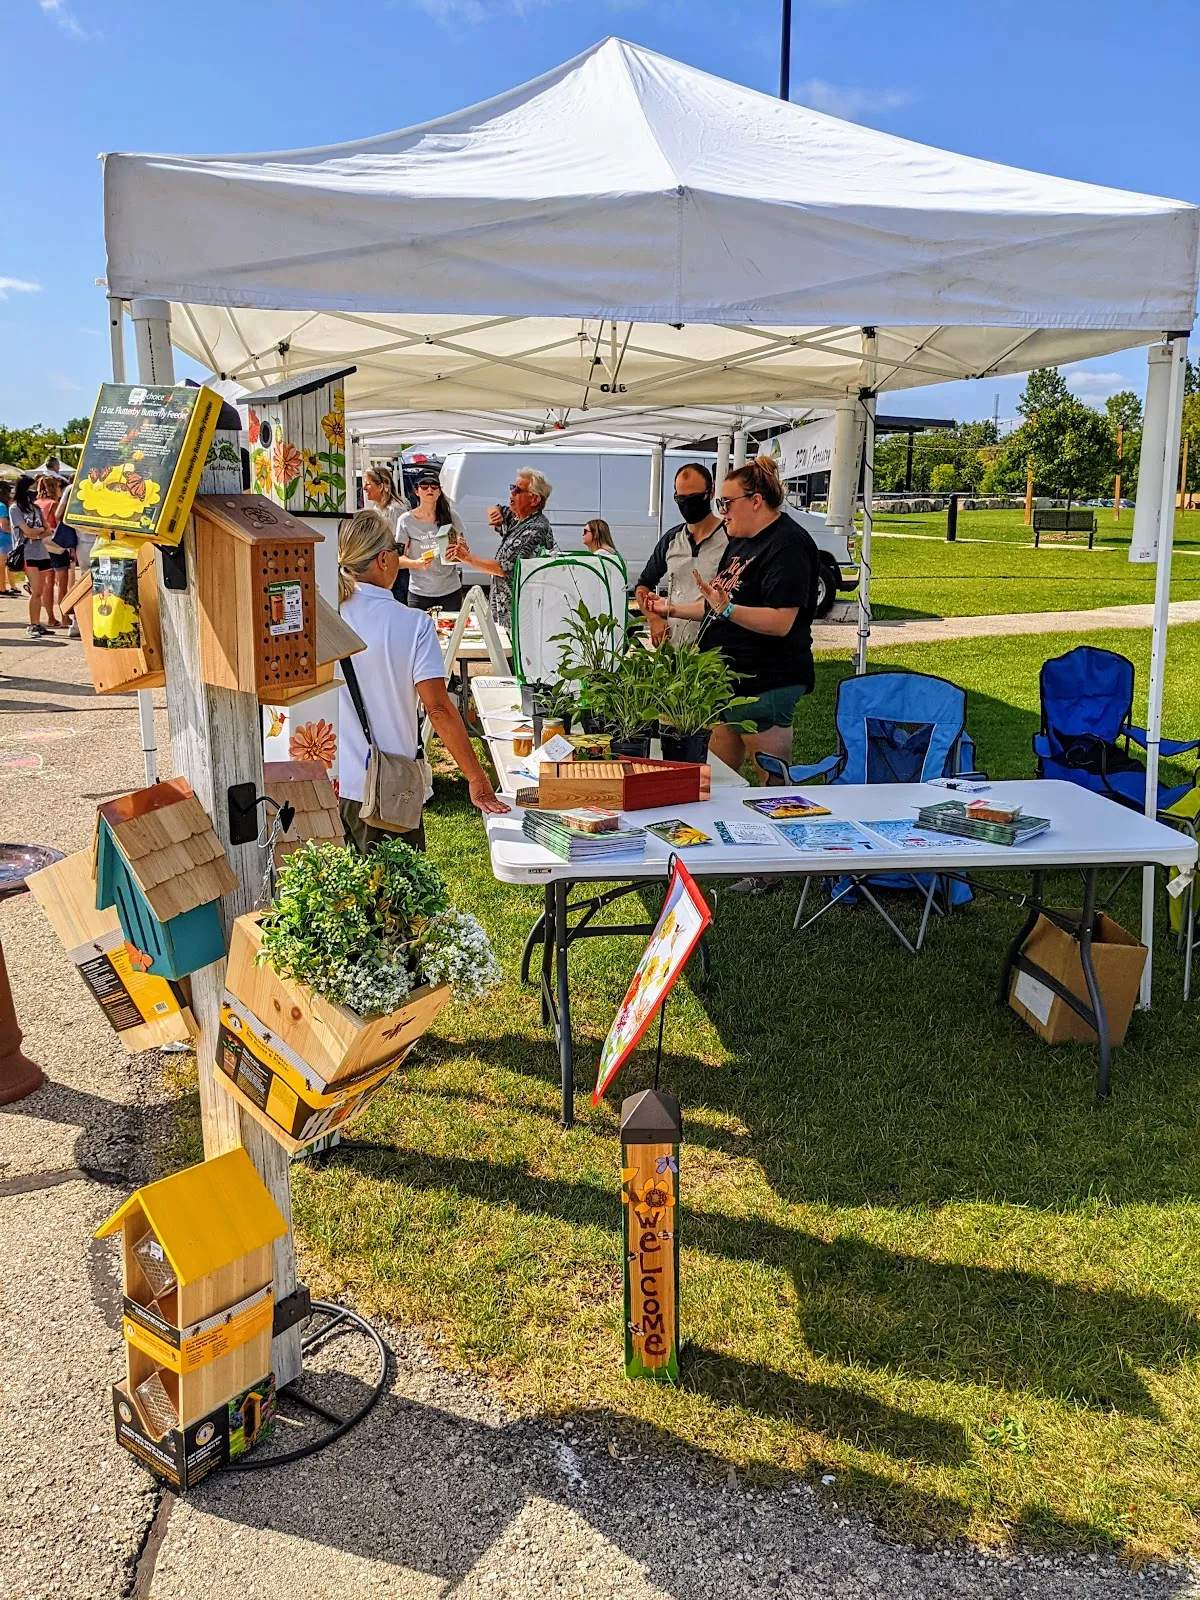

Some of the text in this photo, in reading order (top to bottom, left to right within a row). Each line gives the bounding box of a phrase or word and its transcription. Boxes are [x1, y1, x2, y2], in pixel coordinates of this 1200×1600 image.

[115, 406, 141, 417] Flutterby
[141, 408, 167, 419] Butterfly
[167, 410, 188, 420] Feeder
